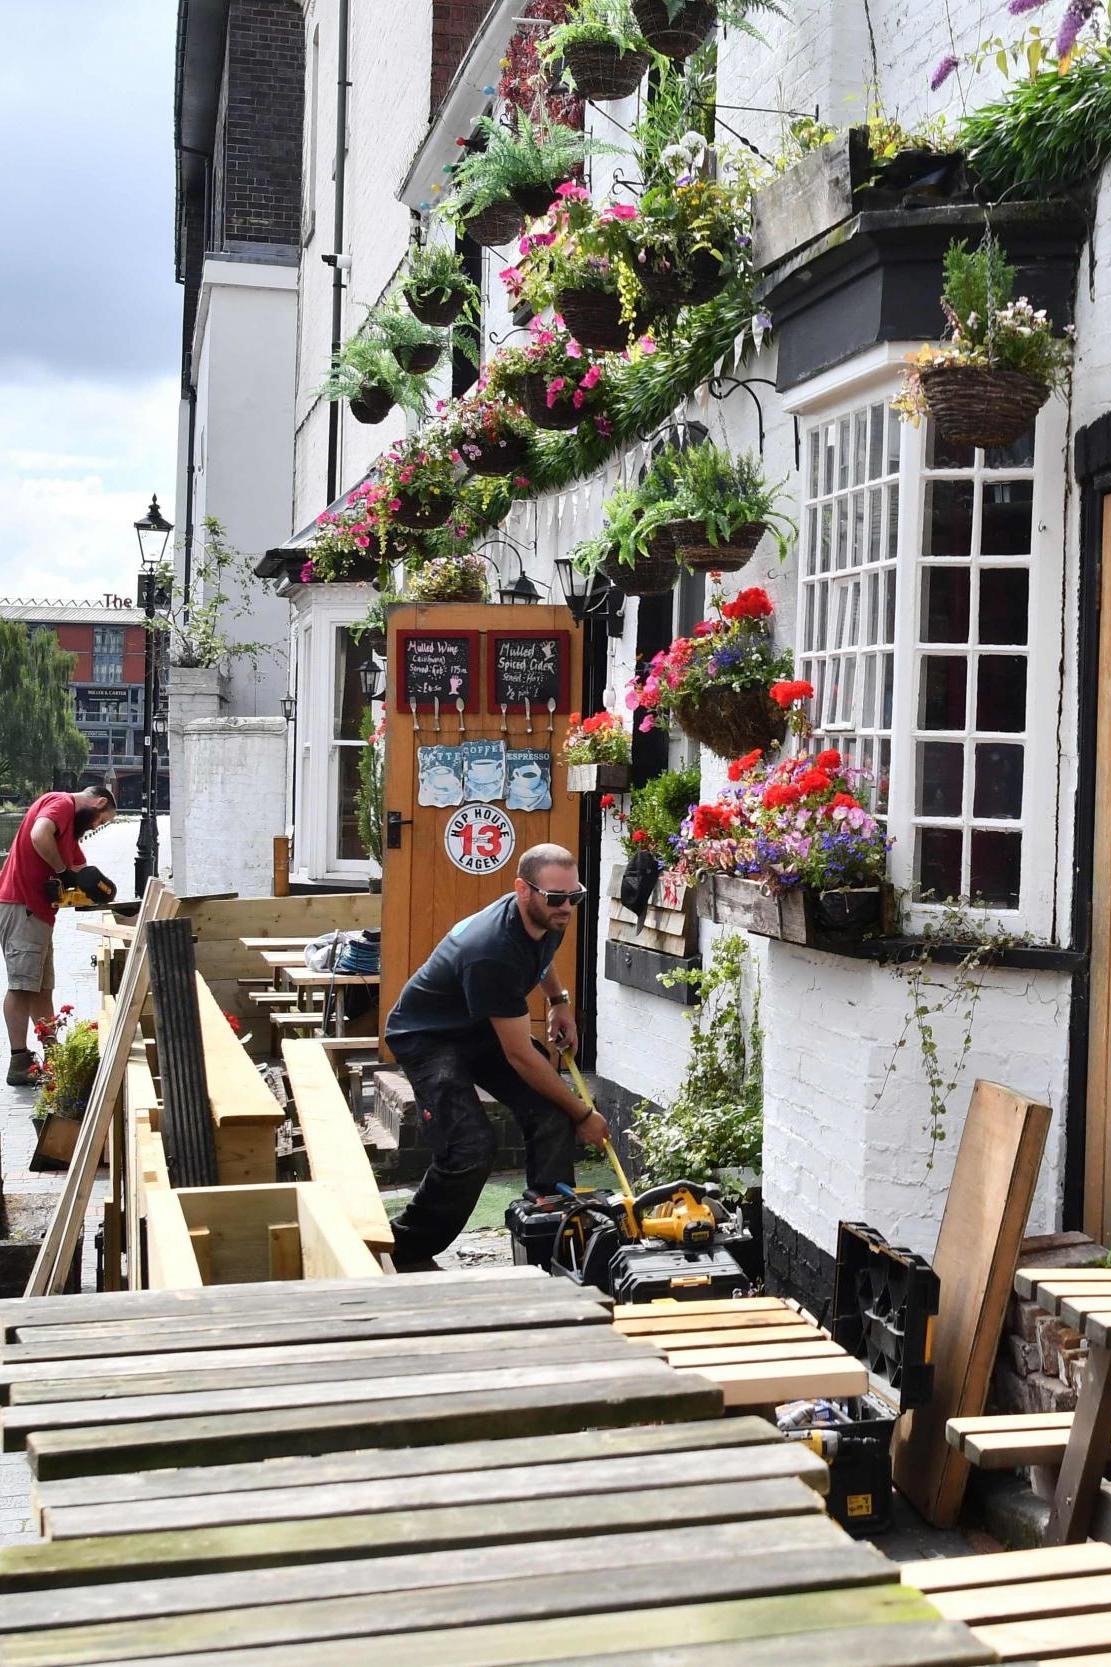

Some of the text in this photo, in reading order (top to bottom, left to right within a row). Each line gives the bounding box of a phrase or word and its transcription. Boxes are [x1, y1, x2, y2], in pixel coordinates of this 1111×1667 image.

[103, 593, 132, 608] The
[407, 641, 459, 655] Mulled Wine
[499, 642, 535, 658] Mulled
[498, 657, 554, 674] Spiced Cider
[507, 752, 550, 760] ESPRESSO
[451, 808, 509, 838] HOP HOUSE
[457, 824, 502, 857] 13
[459, 853, 500, 869] LAGER
